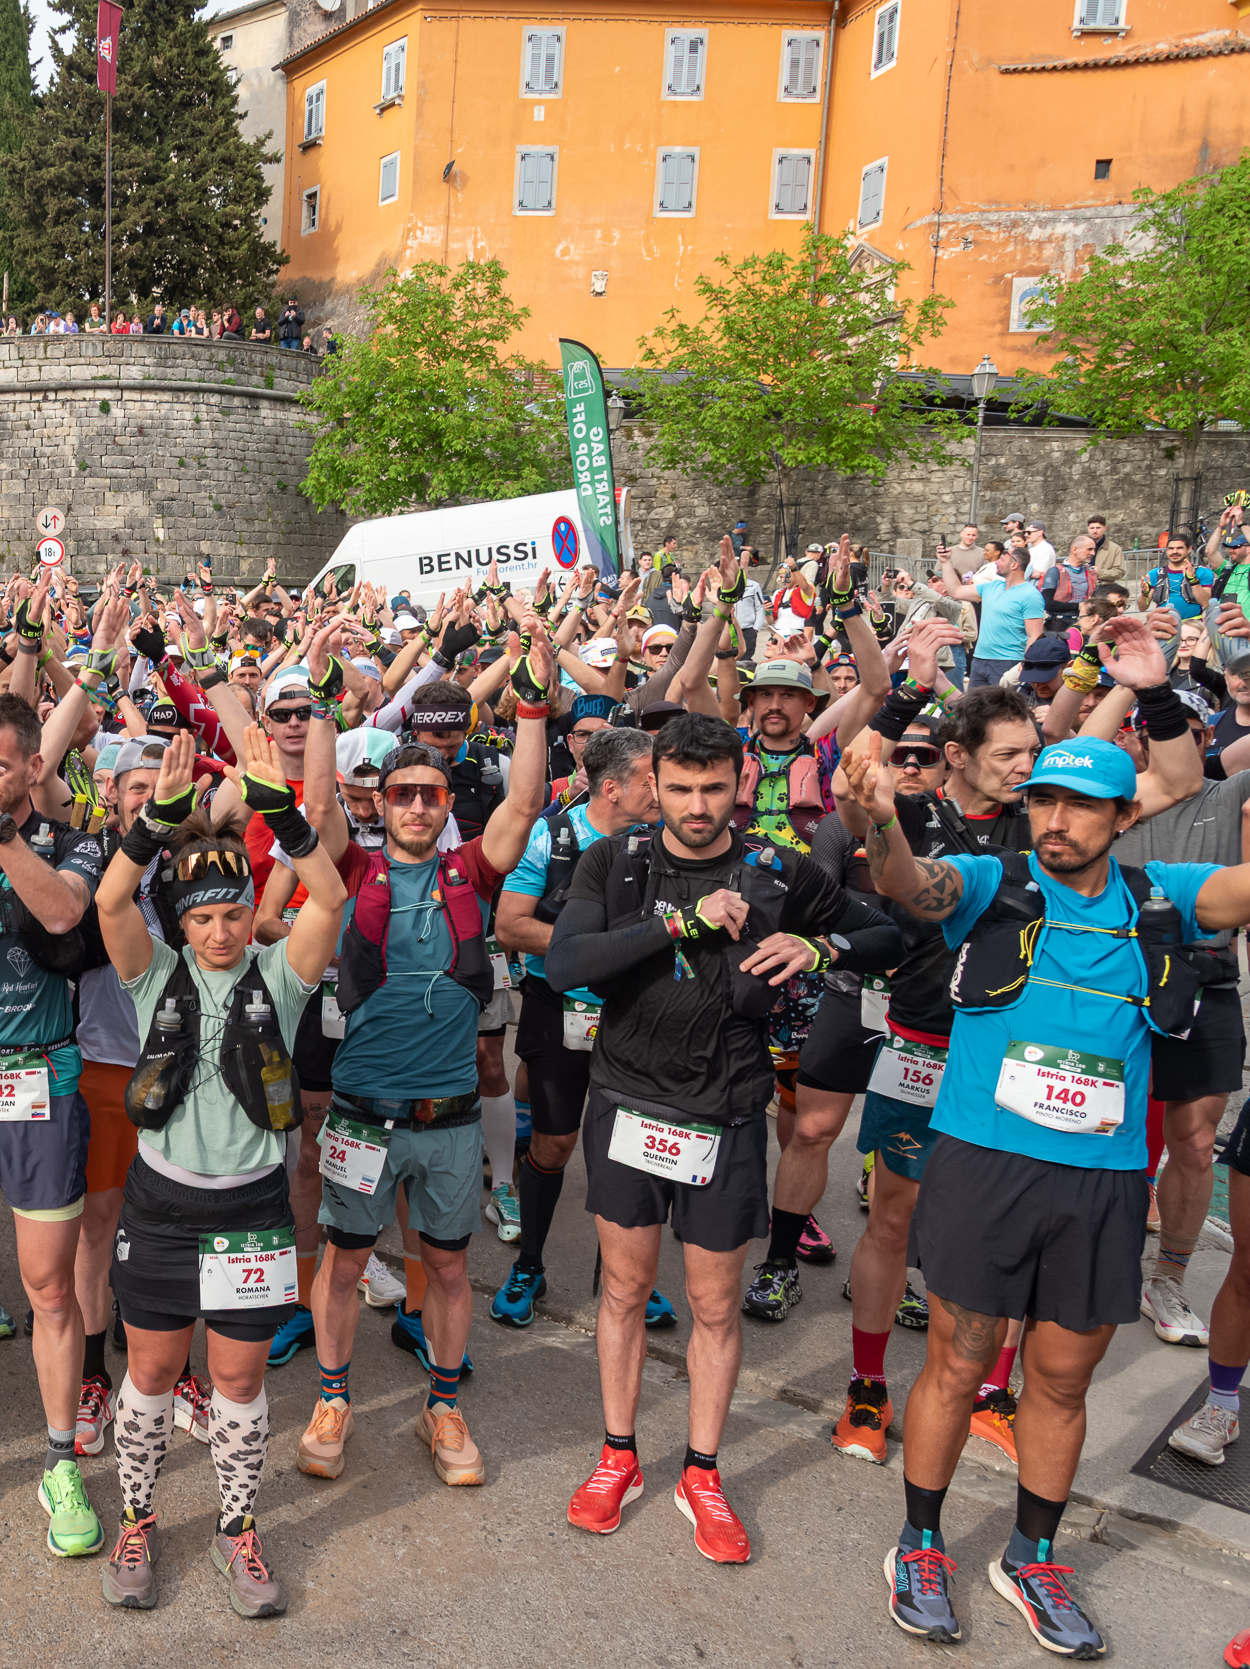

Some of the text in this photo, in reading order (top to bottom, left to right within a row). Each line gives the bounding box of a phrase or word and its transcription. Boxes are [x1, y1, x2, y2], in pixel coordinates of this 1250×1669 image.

[413, 711, 467, 724] TERREX
[175, 888, 239, 914] DYNAFIT
[897, 1053, 944, 1072] Istria 168K
[0, 1072, 22, 1081] 168K
[902, 1067, 934, 1086] 156
[1037, 1068, 1099, 1089] Istria 168K
[898, 1082, 931, 1095] MARKUS
[1046, 1085, 1087, 1107] 140
[1033, 1101, 1087, 1119] FRANCISCO
[1035, 1110, 1082, 1125] PINTO MORENO
[640, 1120, 692, 1140] Istria 168K
[325, 1130, 361, 1150] Istria 168K
[644, 1135, 681, 1157] 356
[329, 1146, 347, 1163] 24
[642, 1151, 678, 1166] QUENTIN
[325, 1158, 348, 1173] MANUEL
[644, 1159, 673, 1171] TRICHEREAU
[227, 1253, 276, 1264] Istria 168K
[242, 1268, 265, 1284] 72
[236, 1285, 271, 1294] ROMANA
